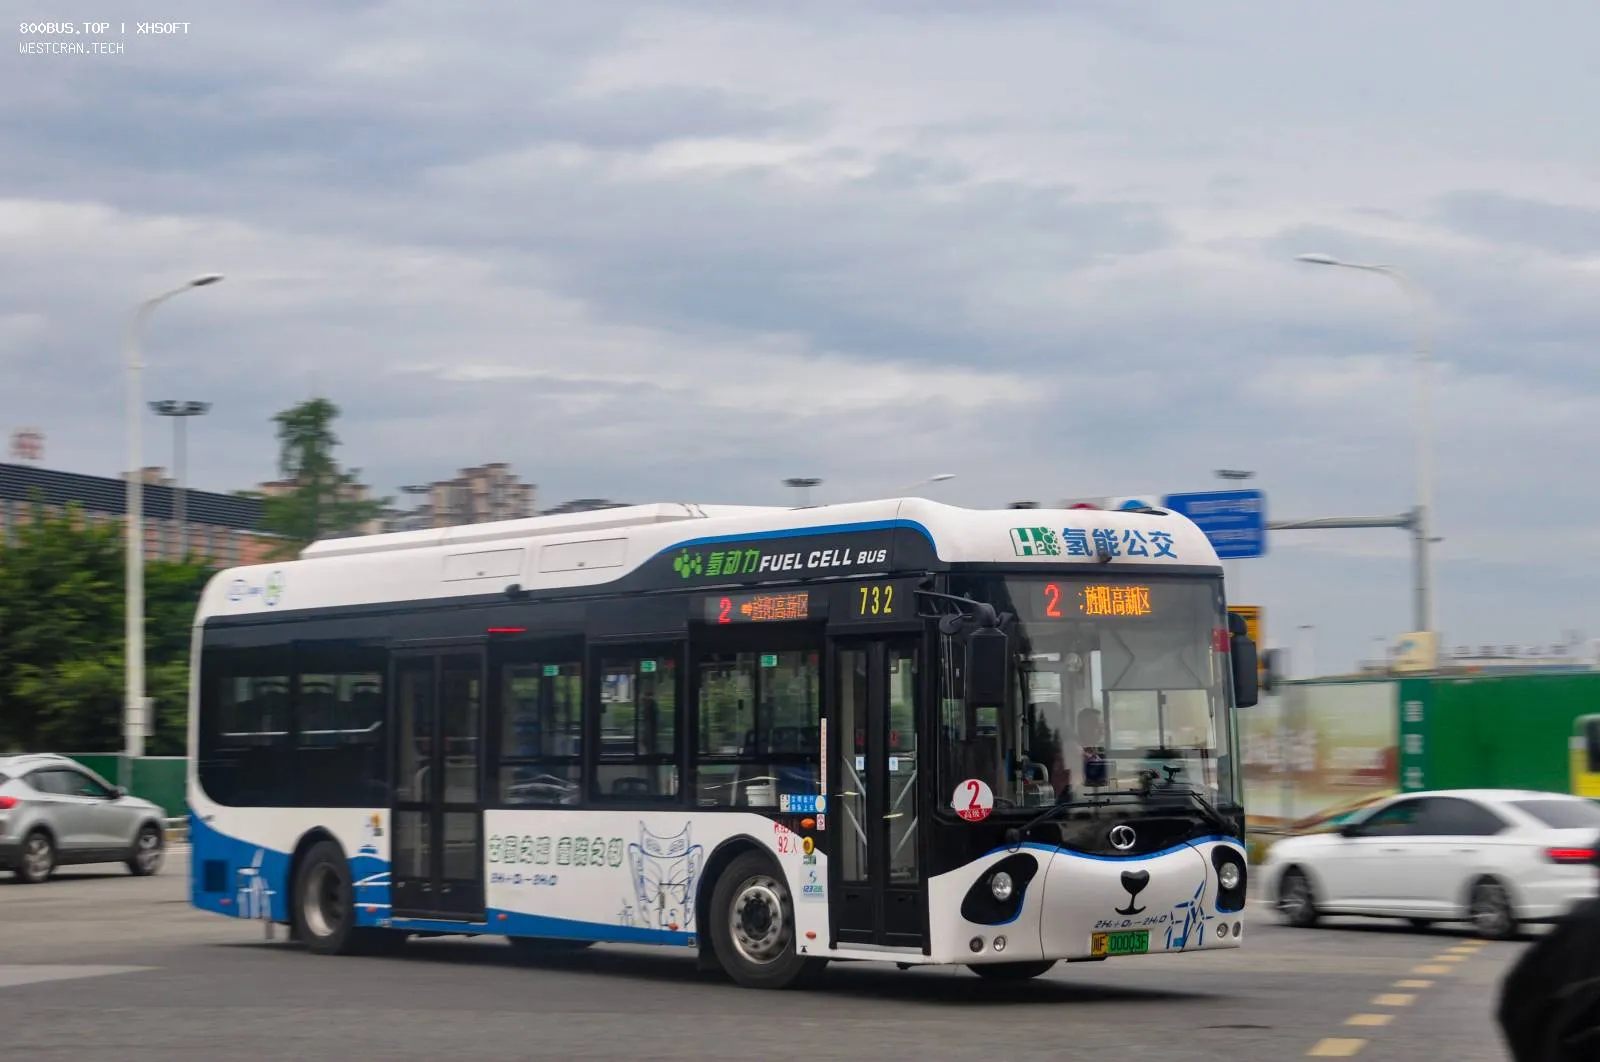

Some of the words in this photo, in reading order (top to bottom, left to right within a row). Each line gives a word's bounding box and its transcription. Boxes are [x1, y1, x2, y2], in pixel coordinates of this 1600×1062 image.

[1062, 527, 1178, 559] 氢能公交
[705, 549, 760, 576] 氢动力
[759, 553, 803, 572] FUEL
[807, 549, 852, 568] CELL
[857, 549, 887, 564] BUS
[719, 597, 732, 624] 2
[860, 585, 893, 615] 732
[1044, 584, 1062, 617] 2
[967, 781, 981, 809] 2
